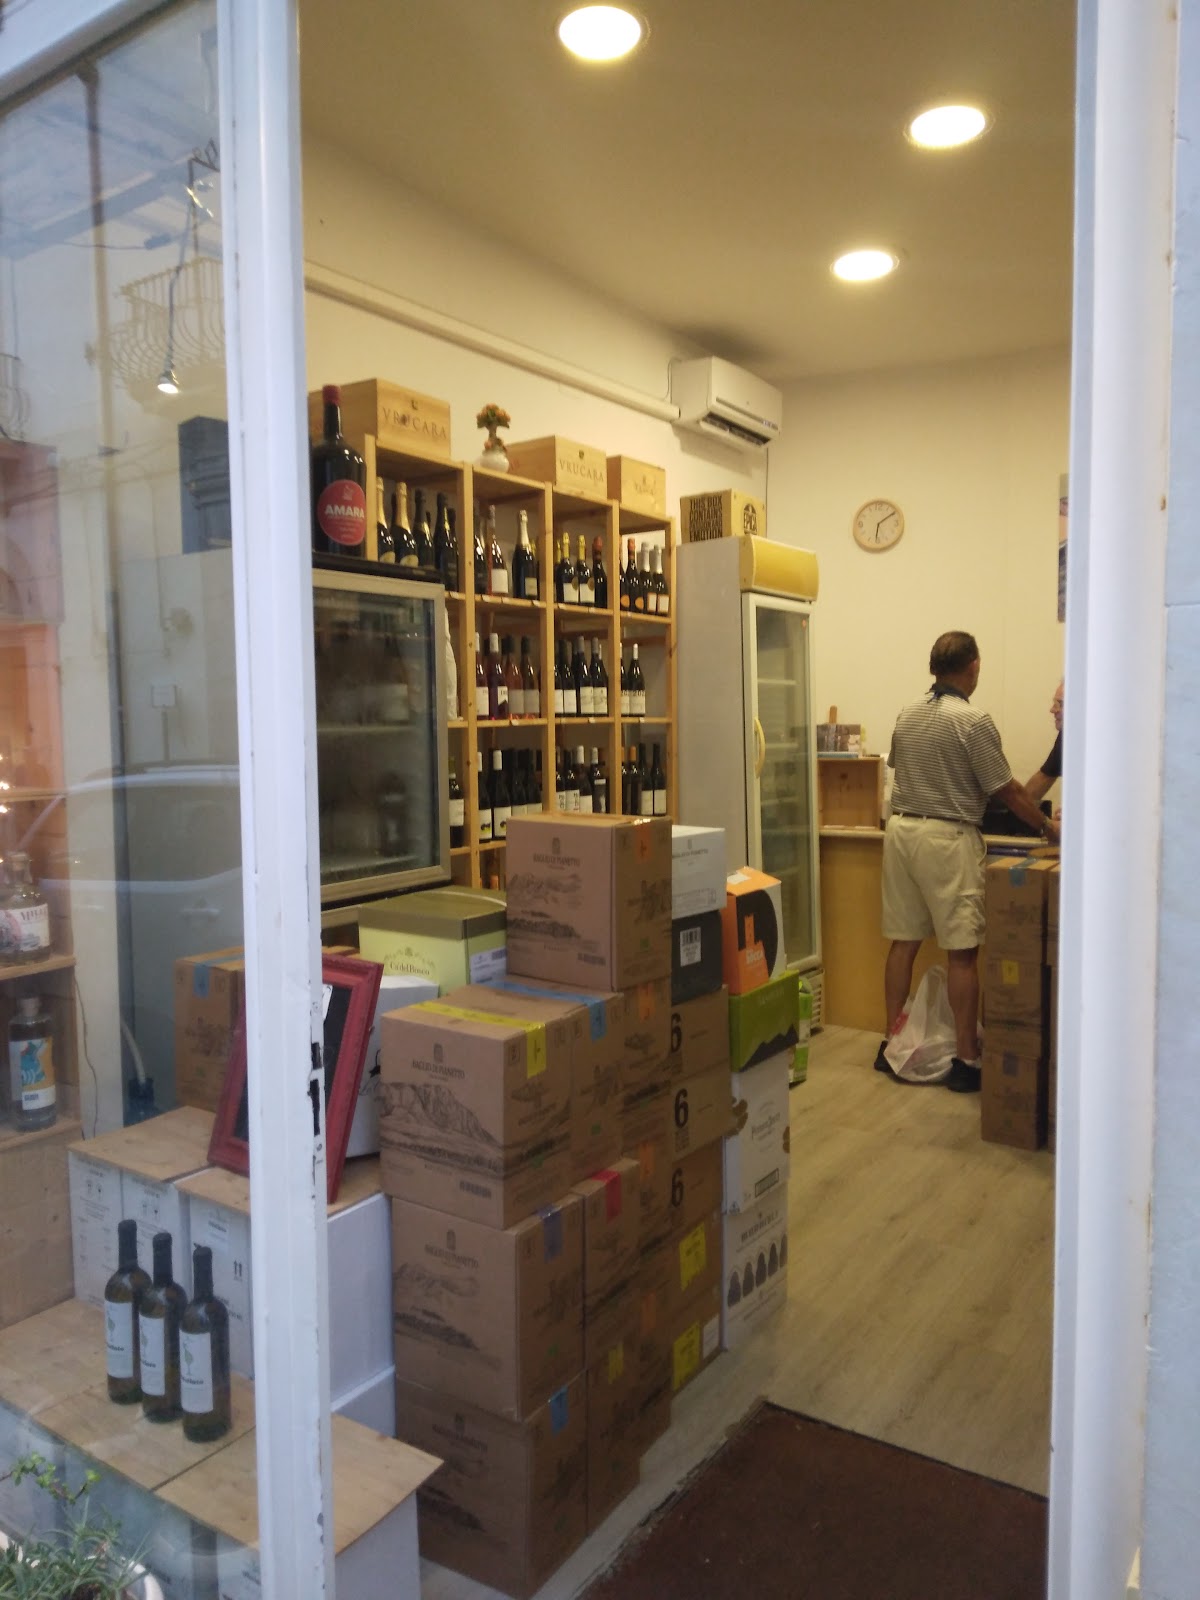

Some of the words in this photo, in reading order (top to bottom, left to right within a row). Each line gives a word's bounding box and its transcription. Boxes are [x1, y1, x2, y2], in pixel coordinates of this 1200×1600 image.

[559, 459, 604, 482] VRUCARA
[324, 503, 365, 518] AMARA
[670, 1012, 682, 1053] 6
[674, 1087, 689, 1129] 6
[671, 1167, 685, 1208] 6
